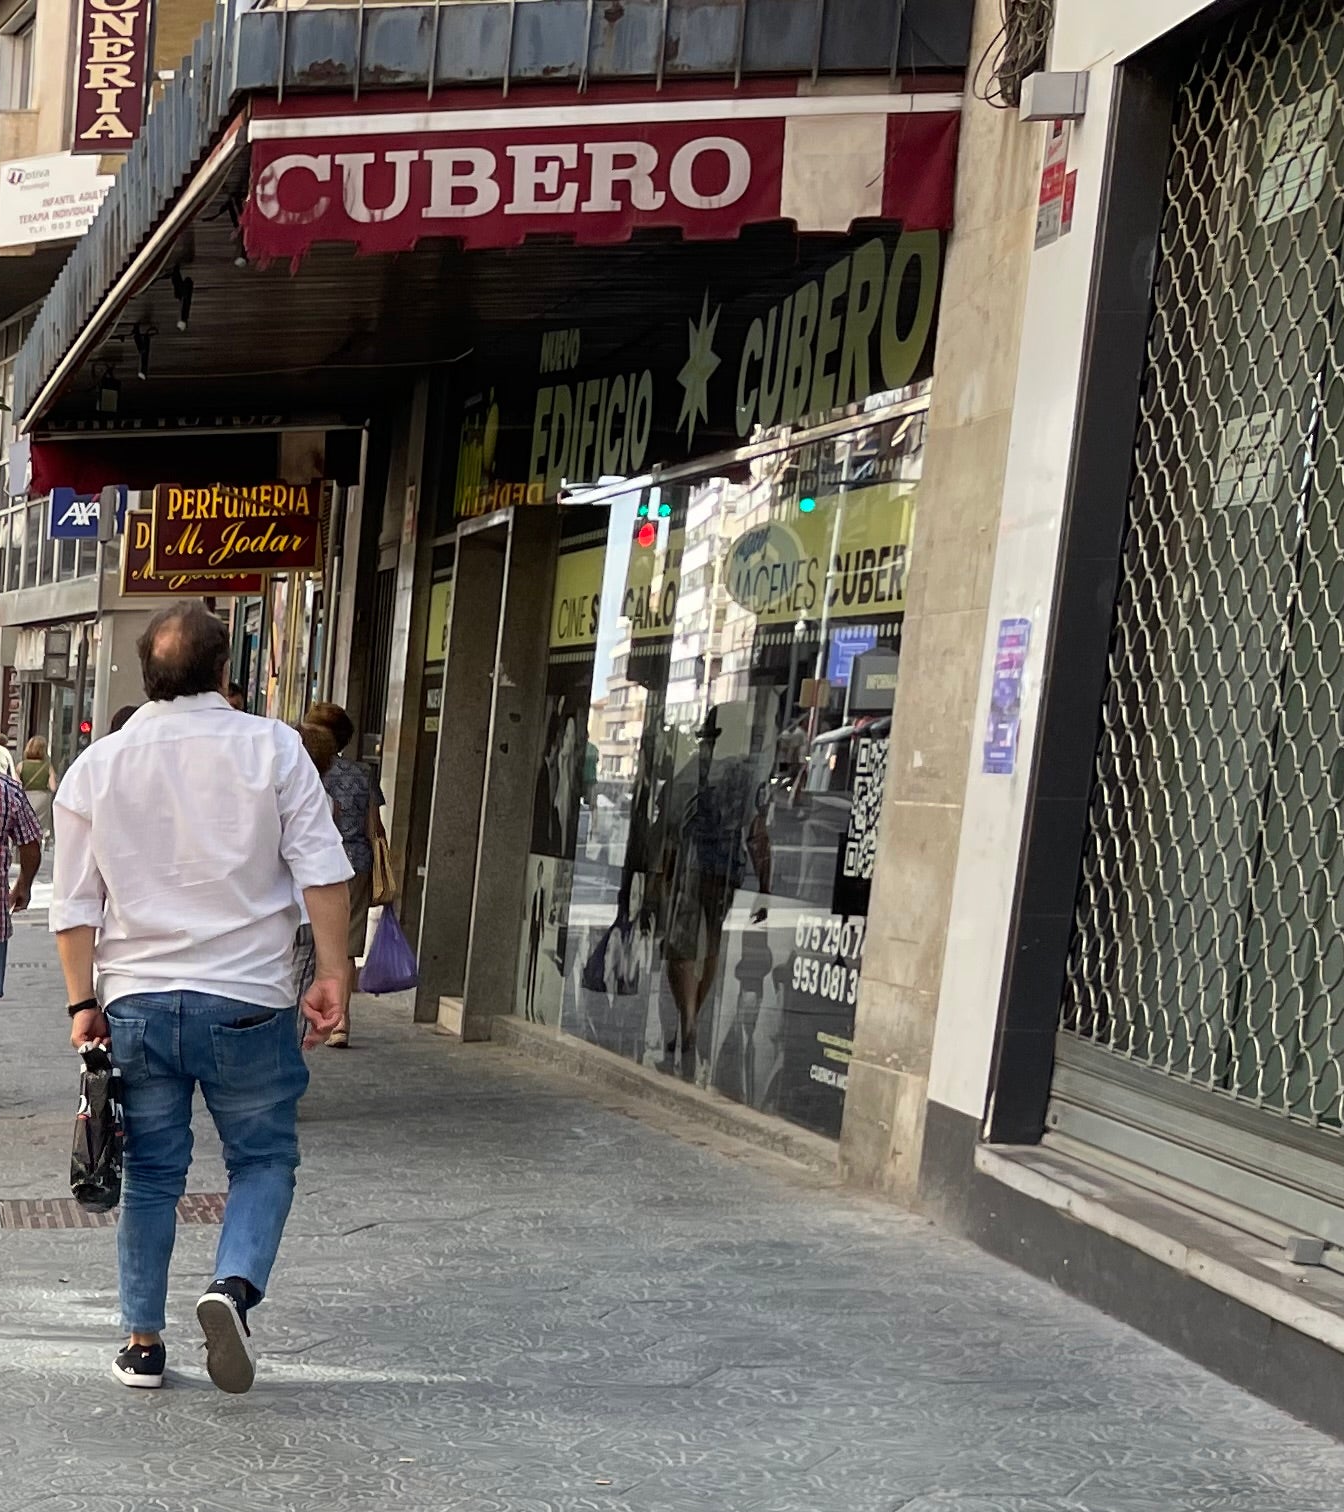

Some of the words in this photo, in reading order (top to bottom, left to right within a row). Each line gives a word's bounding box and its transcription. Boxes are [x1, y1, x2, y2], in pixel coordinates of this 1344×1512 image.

[256, 136, 752, 225] CUBERO
[539, 328, 581, 374] NUEVO
[735, 228, 941, 438] CUBERO
[527, 368, 653, 500] EDIFICIO
[57, 502, 101, 526] AXA
[167, 484, 310, 520] PERFUMERIA
[165, 522, 204, 556] M.
[208, 521, 310, 567] Jodar
[557, 596, 589, 639] CINE
[791, 956, 820, 995] 953
